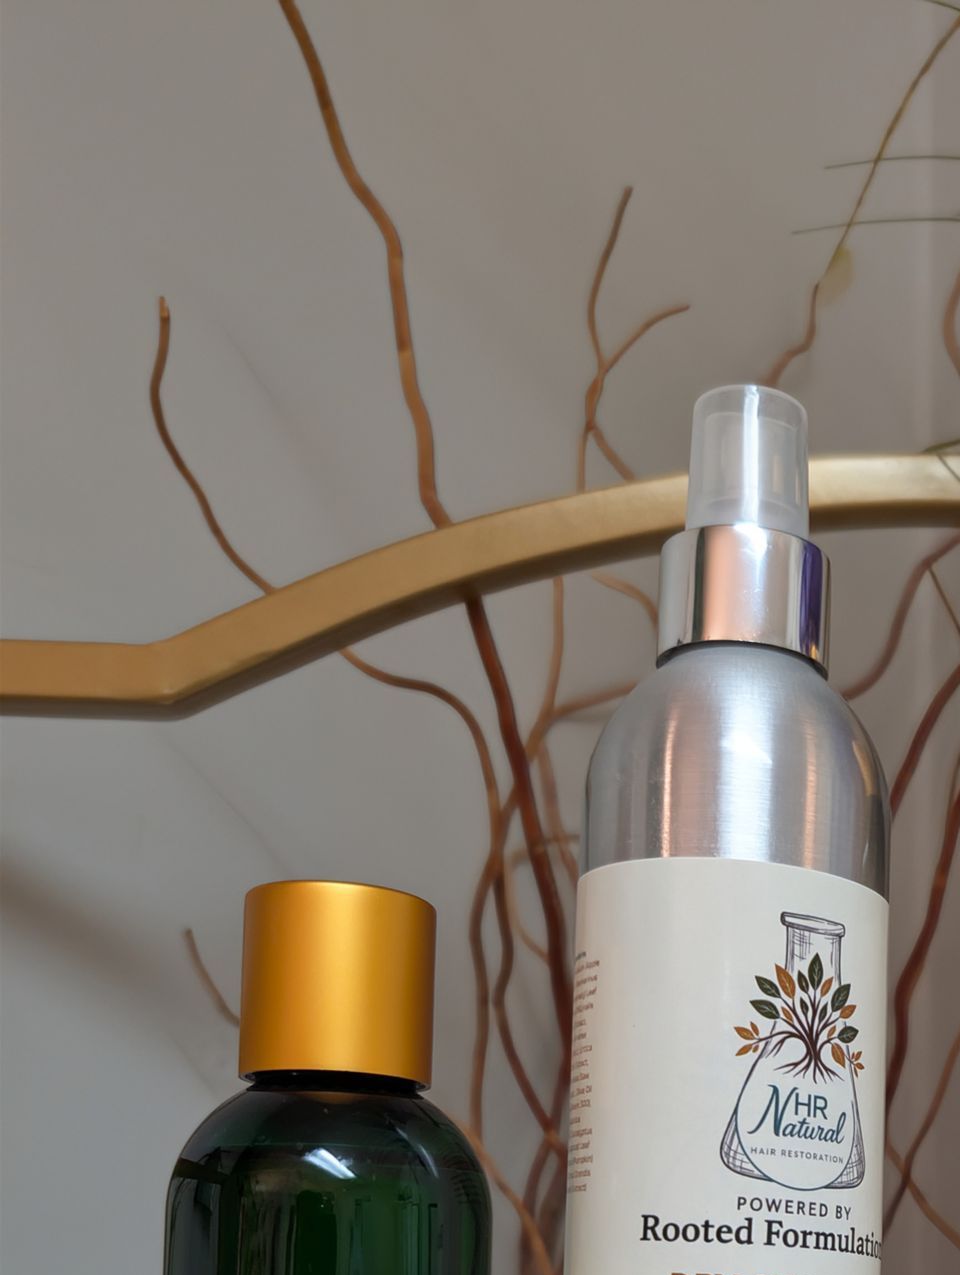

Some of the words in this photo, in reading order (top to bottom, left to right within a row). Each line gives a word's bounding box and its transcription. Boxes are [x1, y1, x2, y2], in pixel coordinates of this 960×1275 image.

[747, 1084, 847, 1145] Natural
[751, 1146, 776, 1157] HAIR
[781, 1148, 844, 1164] RESTORATION
[737, 1196, 828, 1218] POWERED
[836, 1205, 852, 1221] BY
[640, 1214, 753, 1245] Rooted
